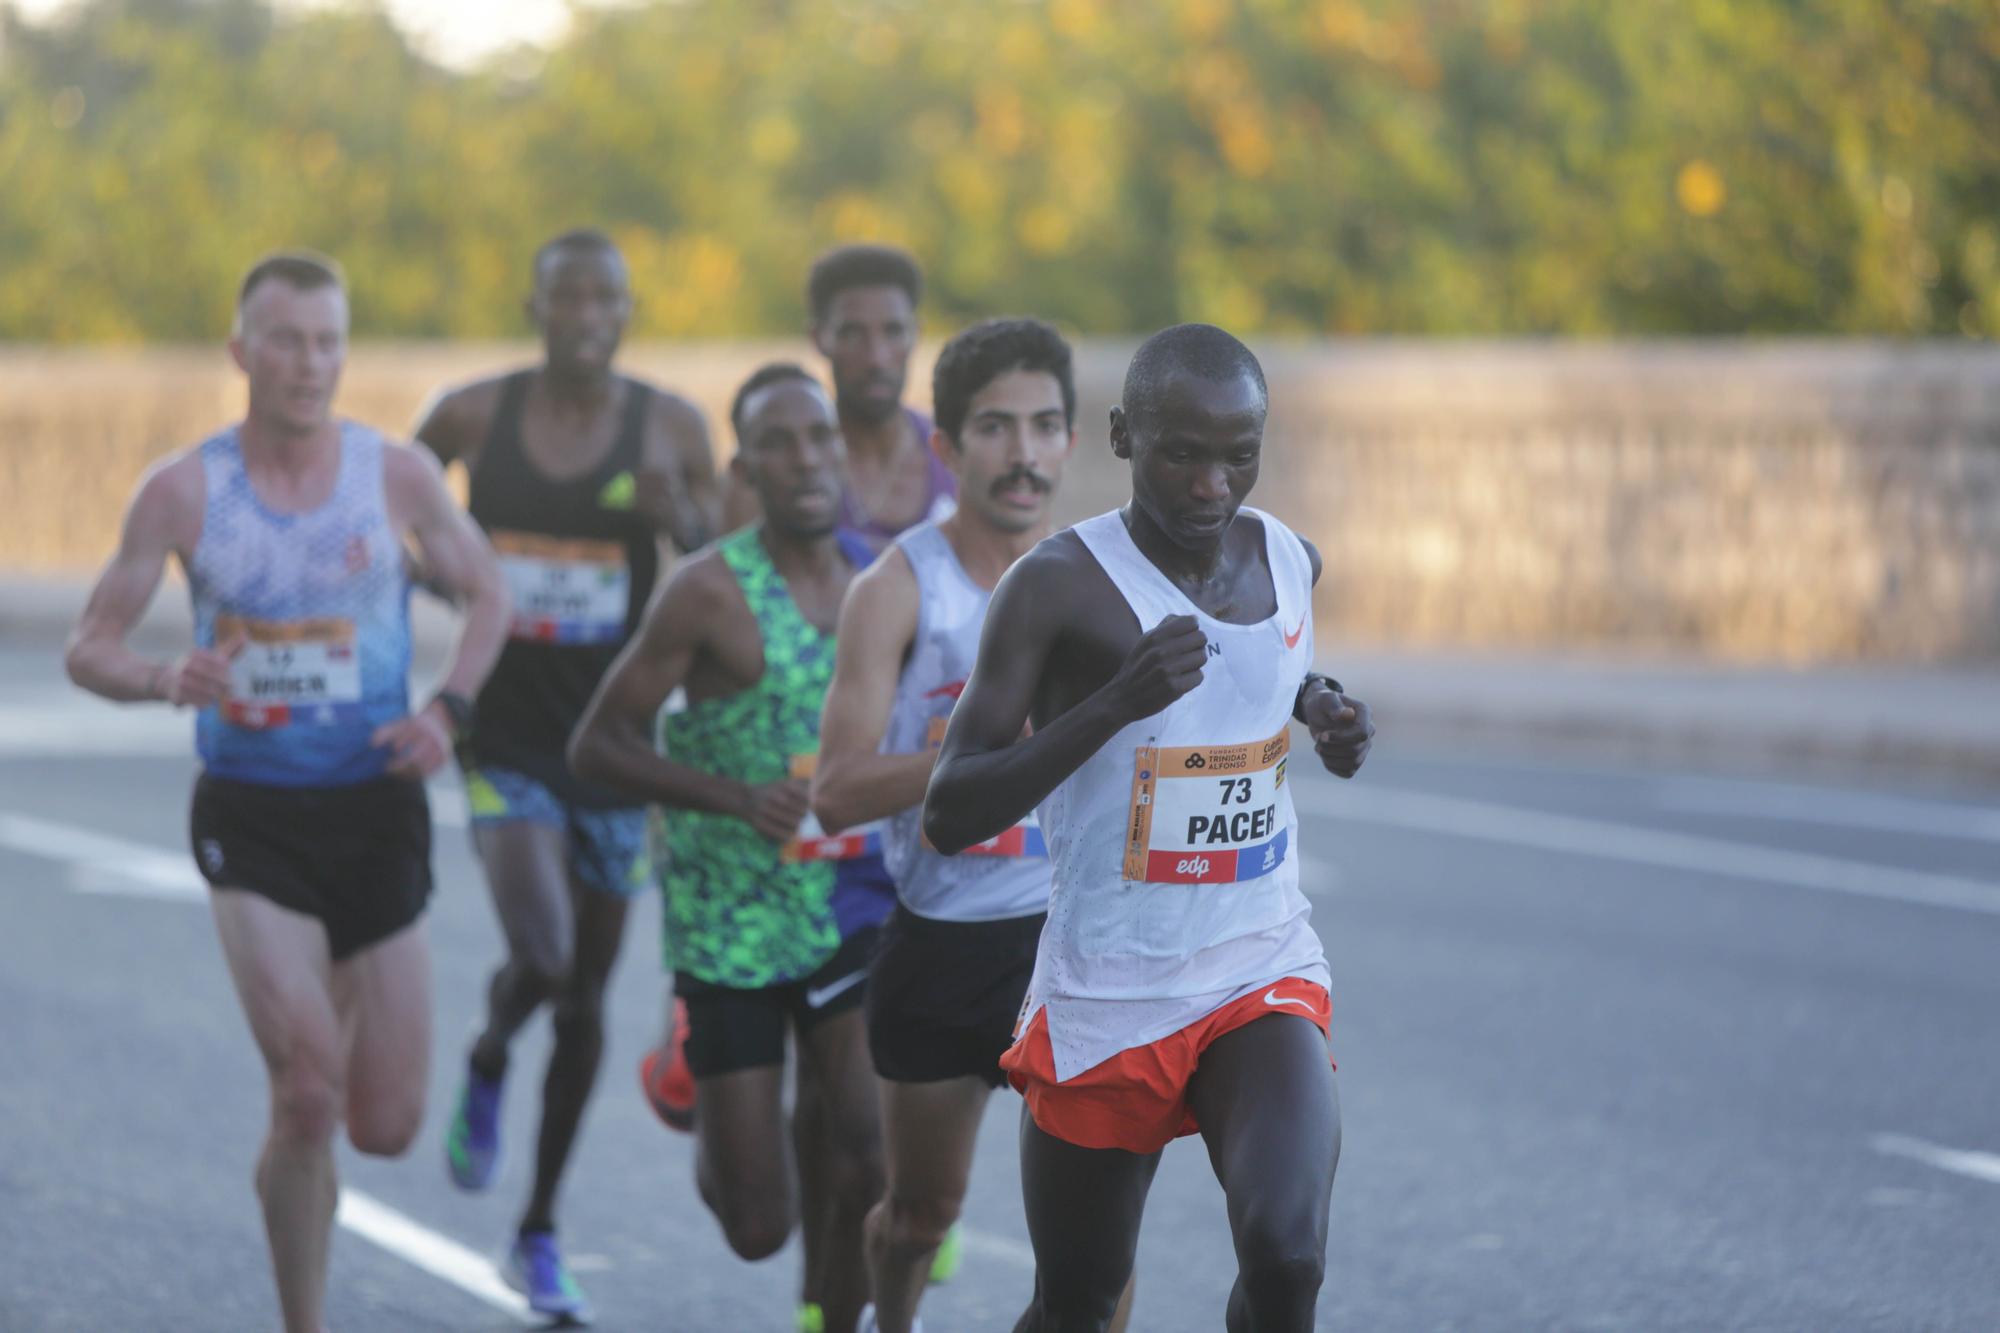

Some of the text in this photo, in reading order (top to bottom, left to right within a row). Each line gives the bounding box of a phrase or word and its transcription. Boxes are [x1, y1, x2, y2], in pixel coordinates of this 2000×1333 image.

[1208, 761, 1247, 770] ALFONSO
[1209, 753, 1247, 763] TRINIDAD
[1219, 777, 1252, 805] 73
[1187, 804, 1275, 845] PACER
[1176, 855, 1210, 878] edp
